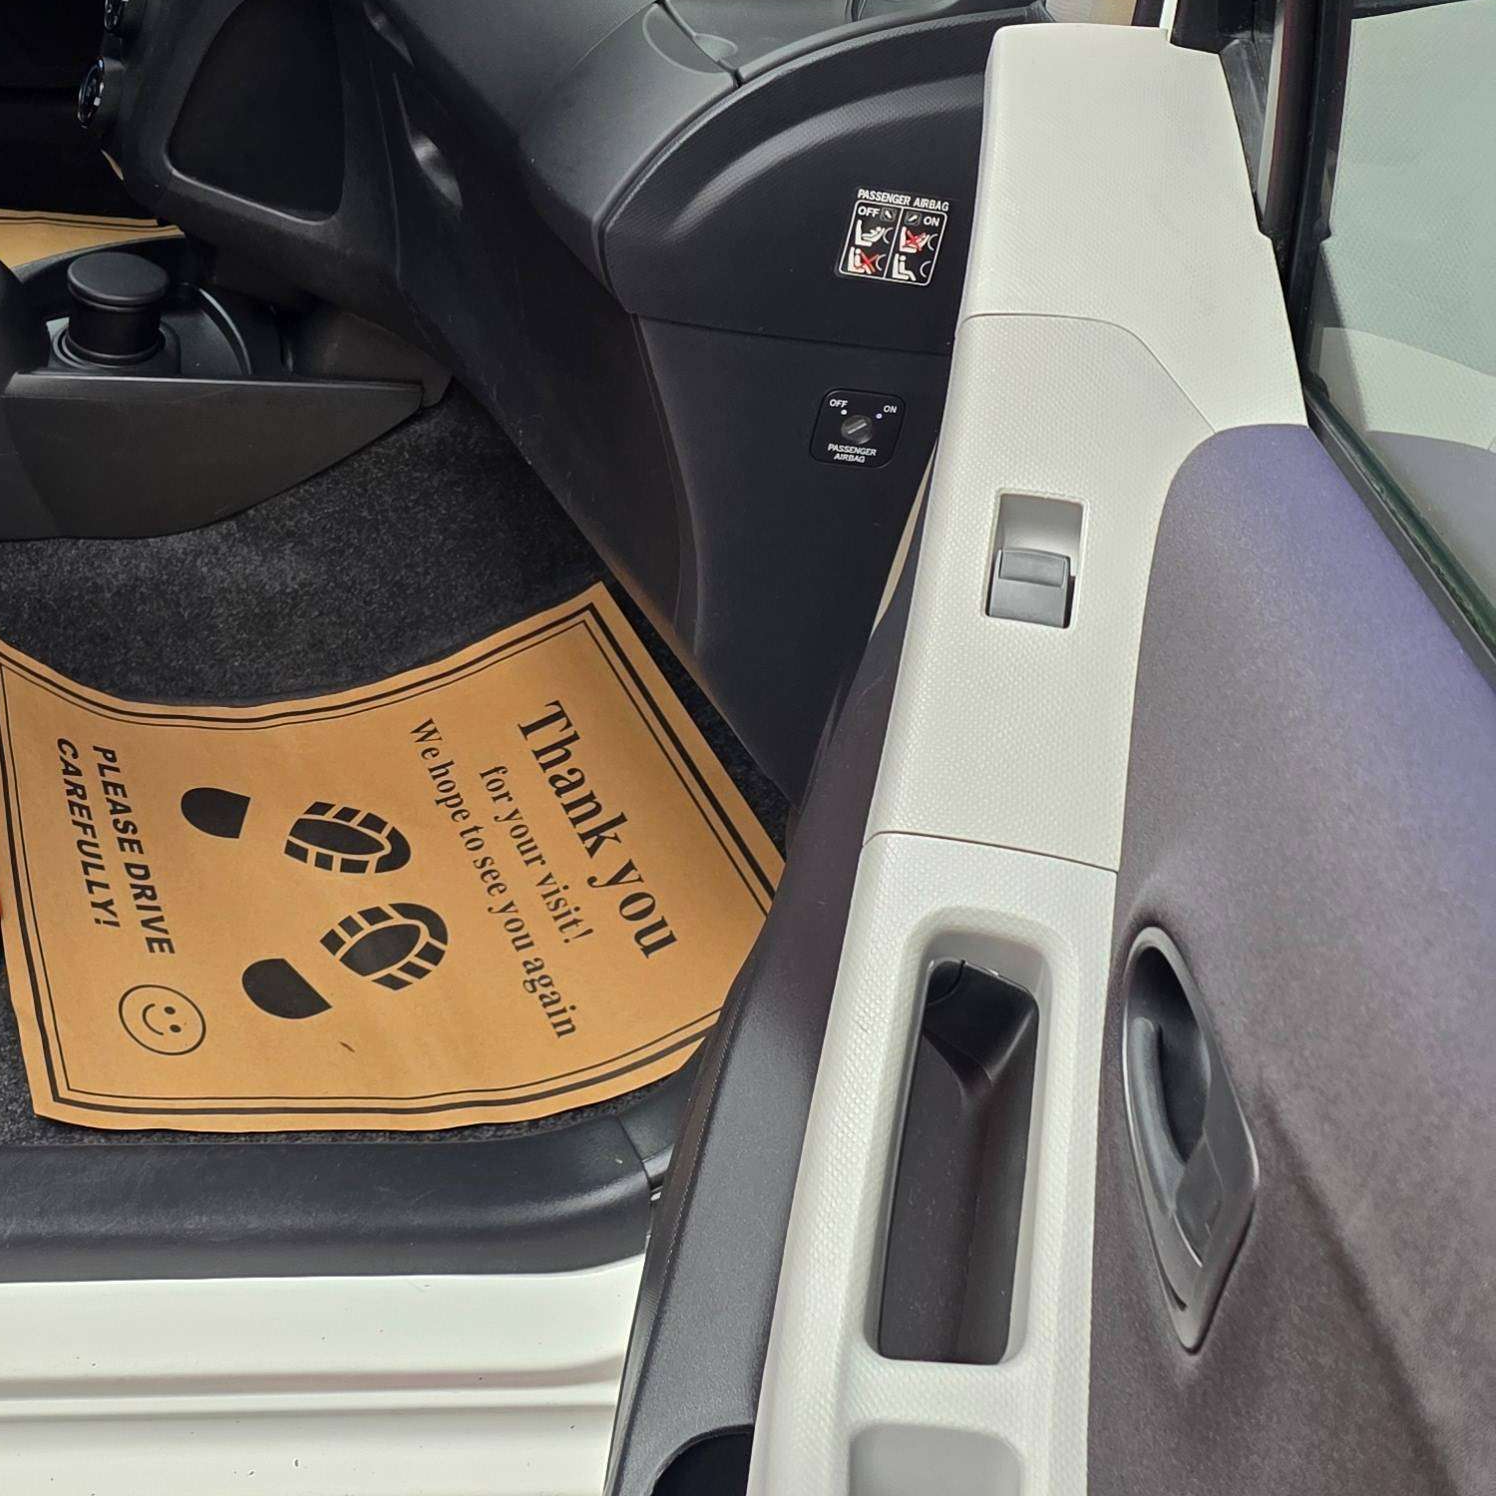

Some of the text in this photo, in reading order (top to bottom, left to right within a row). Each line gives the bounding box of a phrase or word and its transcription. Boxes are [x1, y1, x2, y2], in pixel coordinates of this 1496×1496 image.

[857, 188, 949, 212] PASSENGER AIRBAG
[857, 206, 880, 218] OFF
[923, 216, 940, 226] ON
[829, 399, 848, 408] OFF
[883, 405, 897, 413] ON
[827, 443, 877, 456] PASSENGER
[833, 453, 865, 463] AIRBAG
[56, 737, 121, 929] CAREFULLY!
[517, 699, 678, 959] Thank you
[92, 745, 176, 955] PLEASE DRIVE
[479, 765, 594, 944] for your visit!
[410, 717, 577, 1039] We hope to see you again
